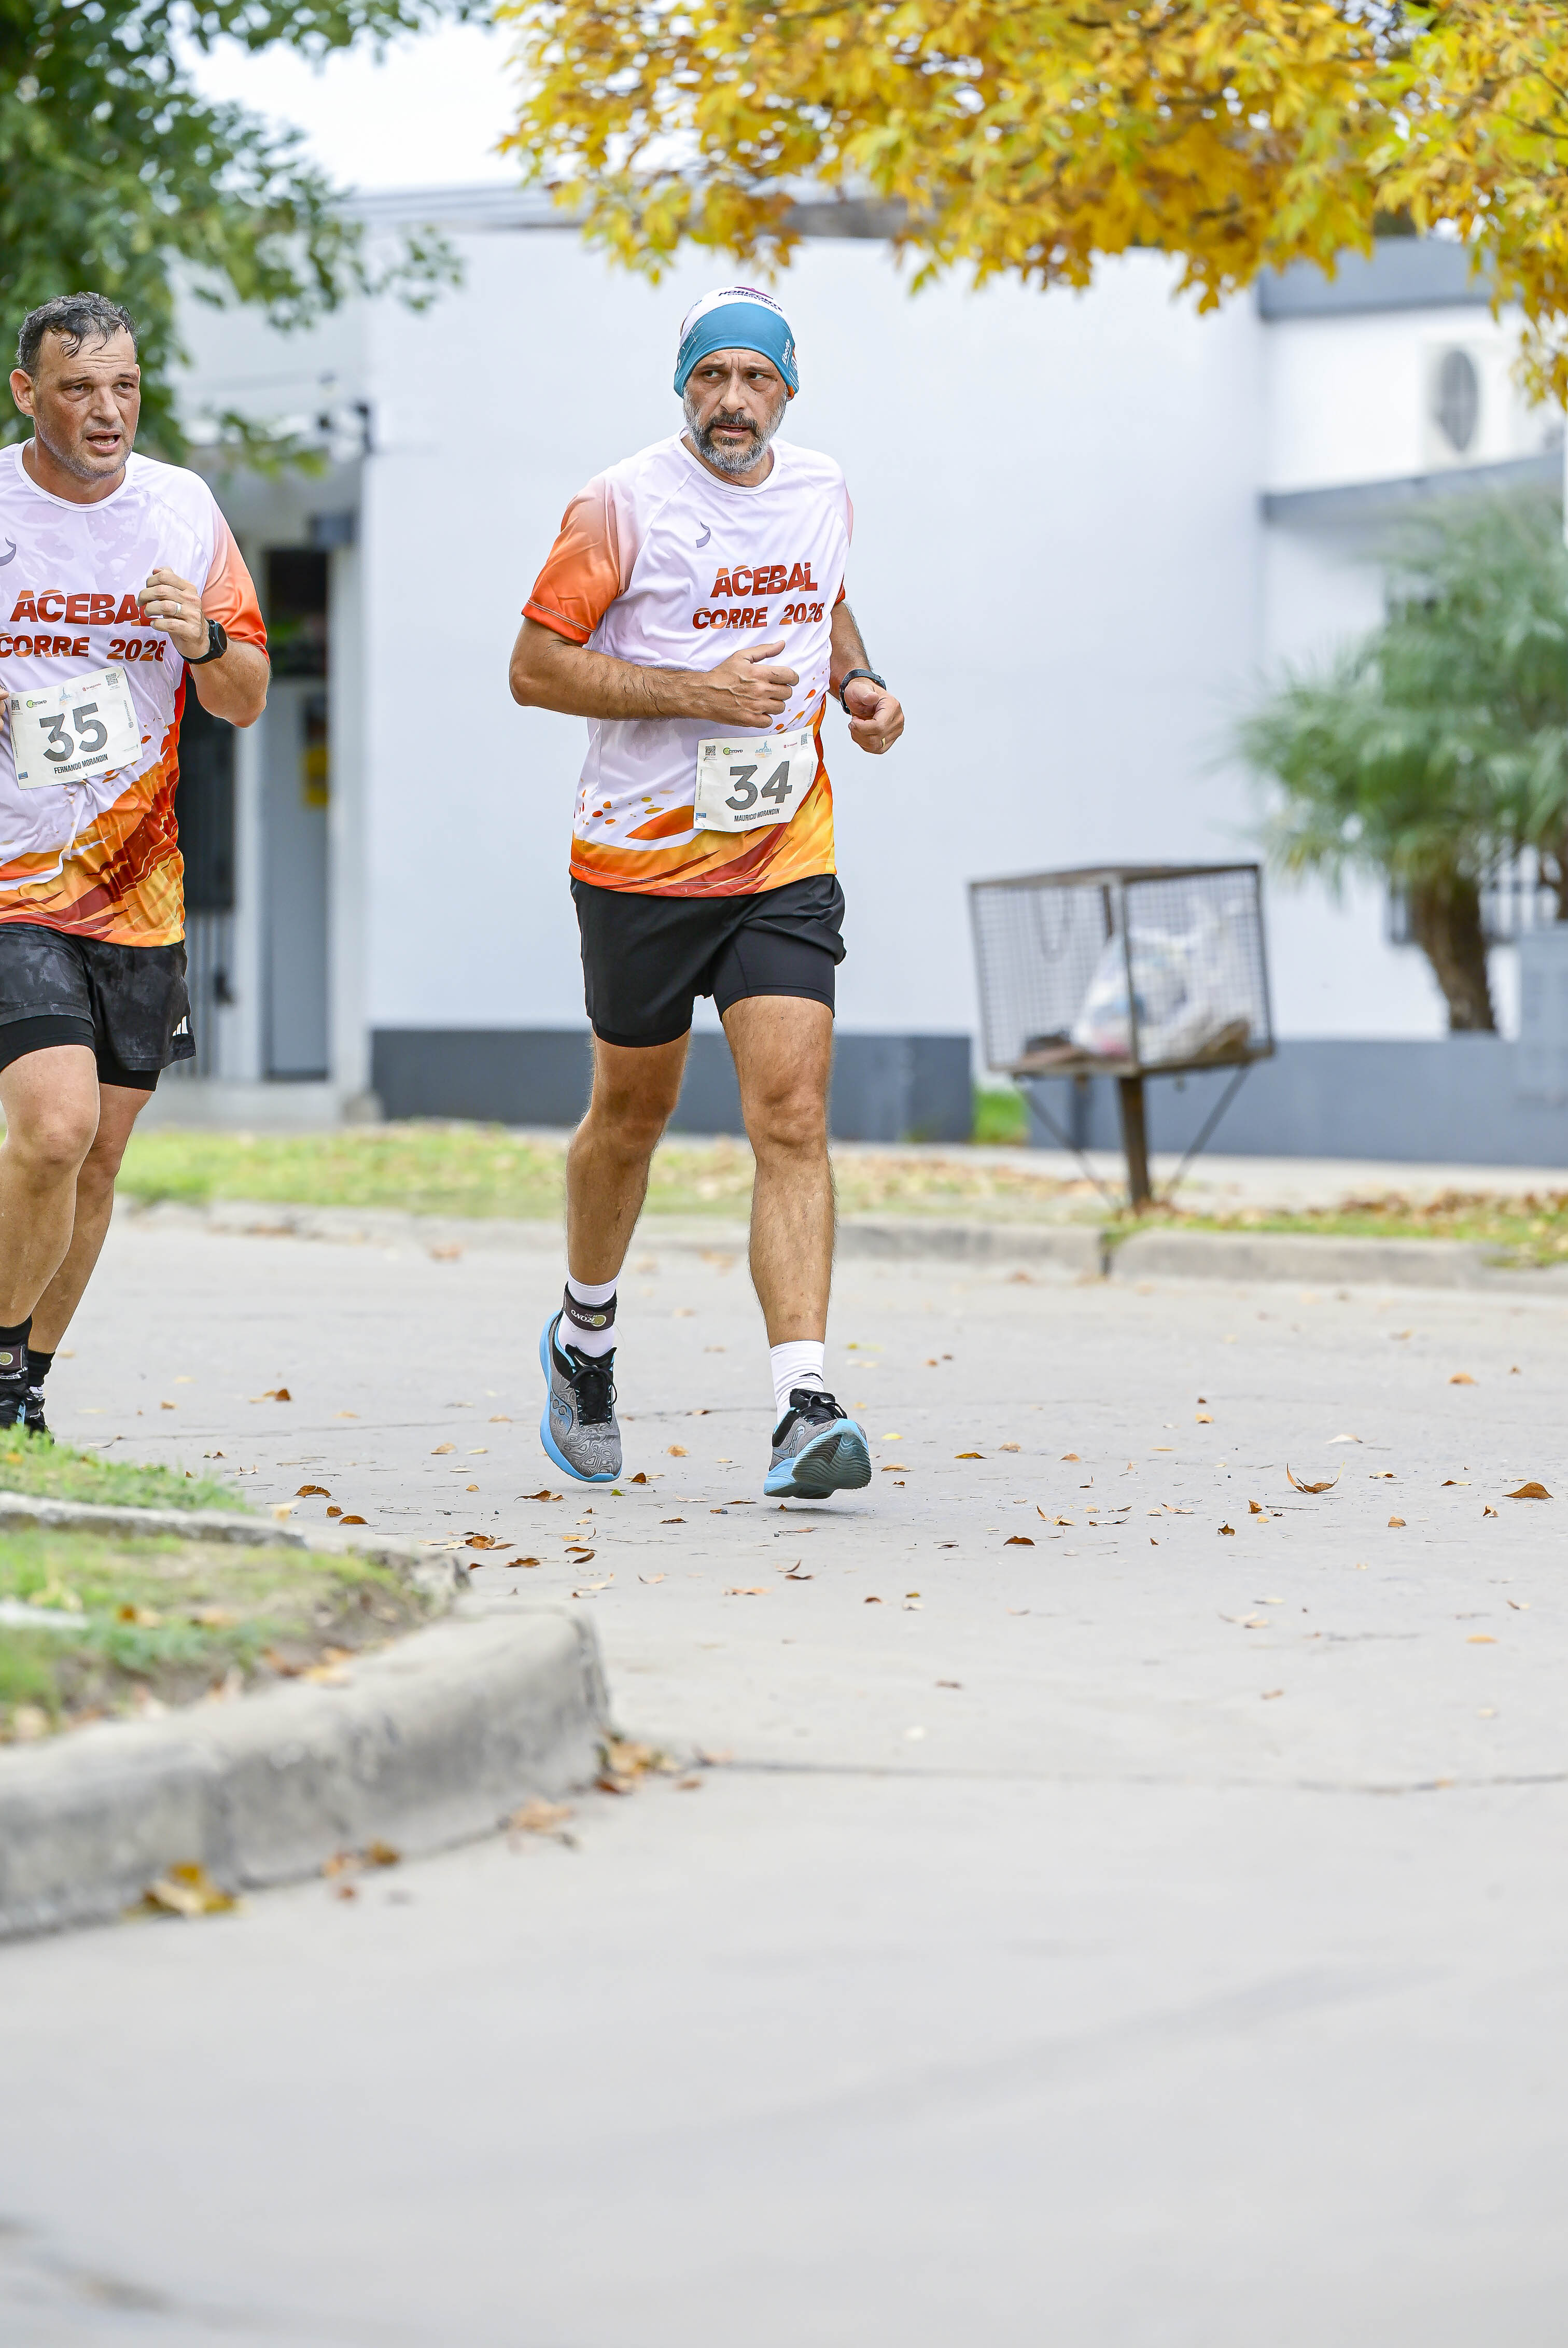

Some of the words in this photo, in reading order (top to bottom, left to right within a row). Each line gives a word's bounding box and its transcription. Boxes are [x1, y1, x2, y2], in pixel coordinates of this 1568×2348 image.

[709, 562, 818, 598] ACEBAL
[692, 607, 768, 630] CORRE
[779, 602, 825, 625] 2026
[0, 633, 90, 658] CORRE
[106, 638, 167, 662] 2026
[39, 702, 108, 762] 35
[53, 762, 82, 774] FERNANDO
[81, 753, 108, 768] MORANDIN
[725, 760, 793, 810] 34
[734, 813, 757, 822] MAURICIO
[757, 808, 780, 818] MORANDIN
